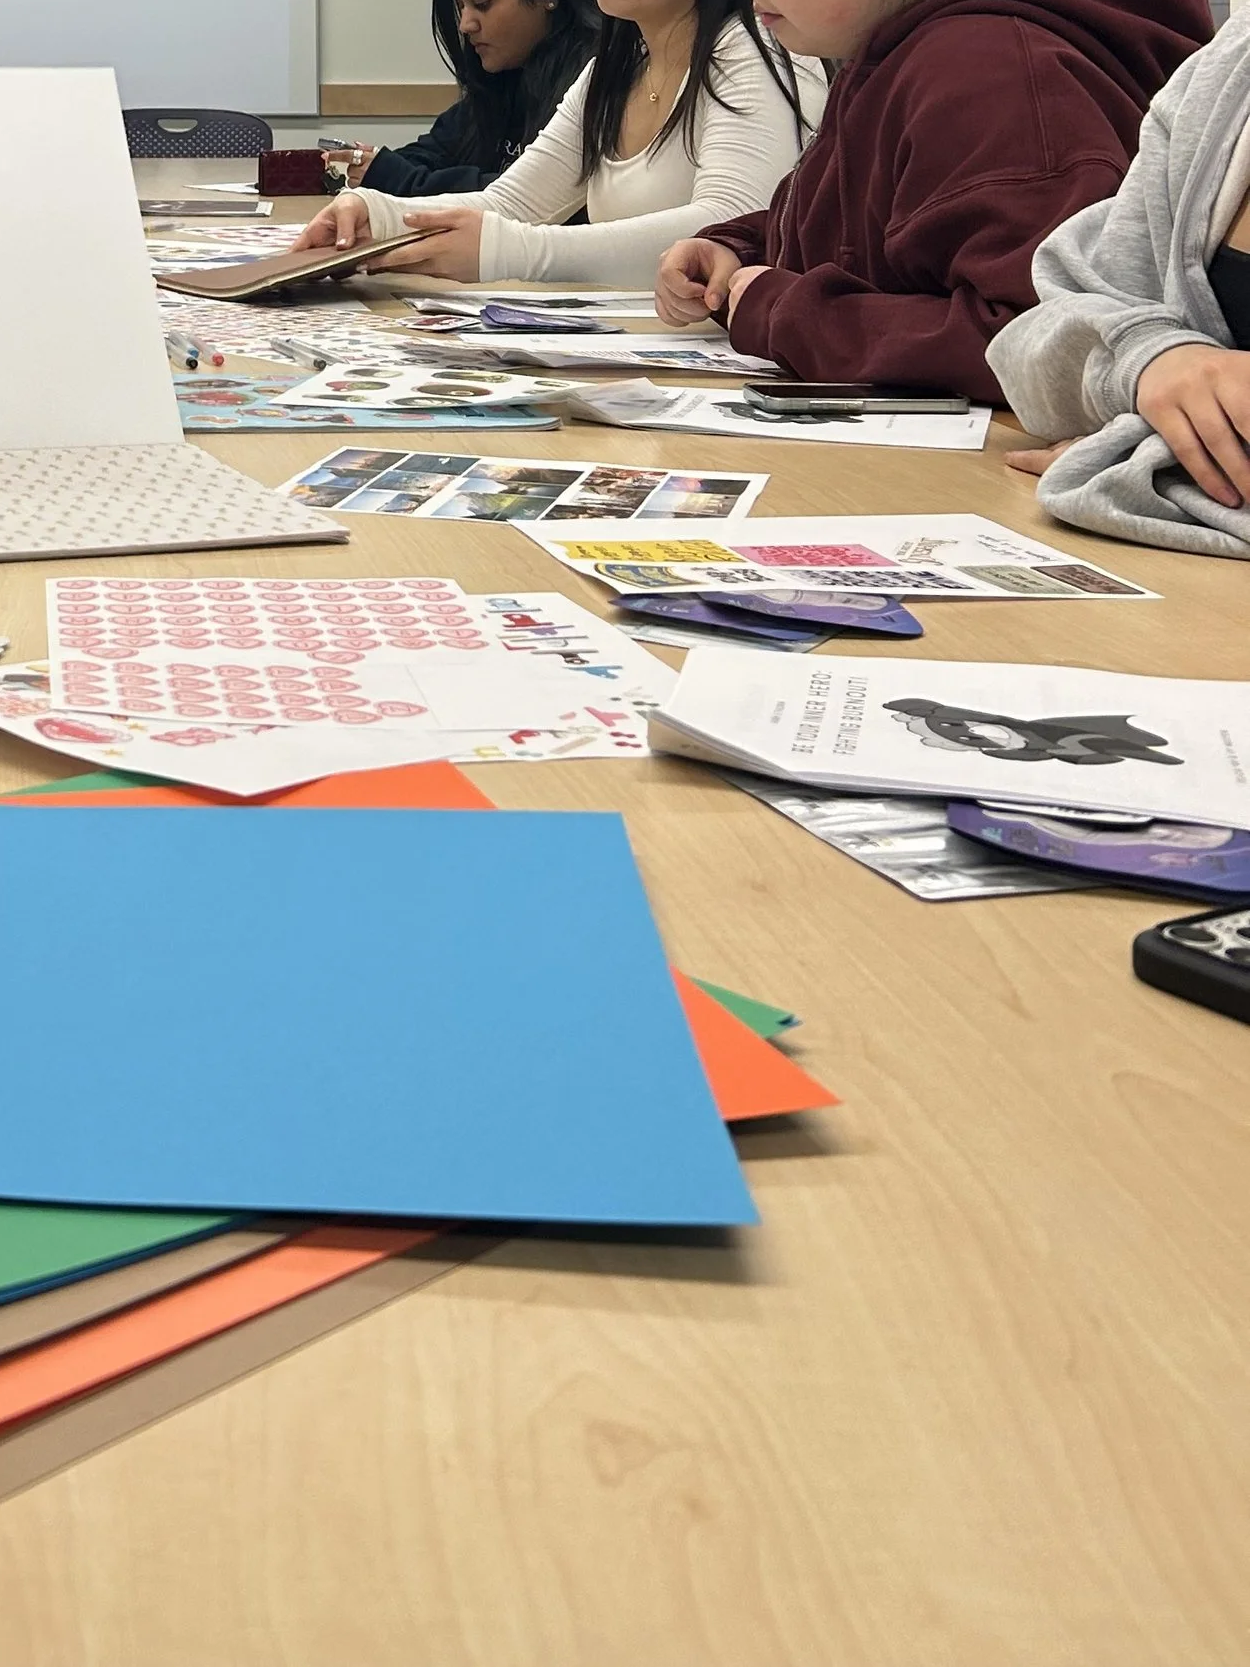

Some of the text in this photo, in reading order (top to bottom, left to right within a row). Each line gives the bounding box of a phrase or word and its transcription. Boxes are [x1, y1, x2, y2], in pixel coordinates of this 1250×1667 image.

[802, 700, 827, 723] INNER
[832, 676, 869, 755] FIGHTING BURNOUT!
[794, 723, 820, 742] YOUR
[791, 742, 815, 754] BE
